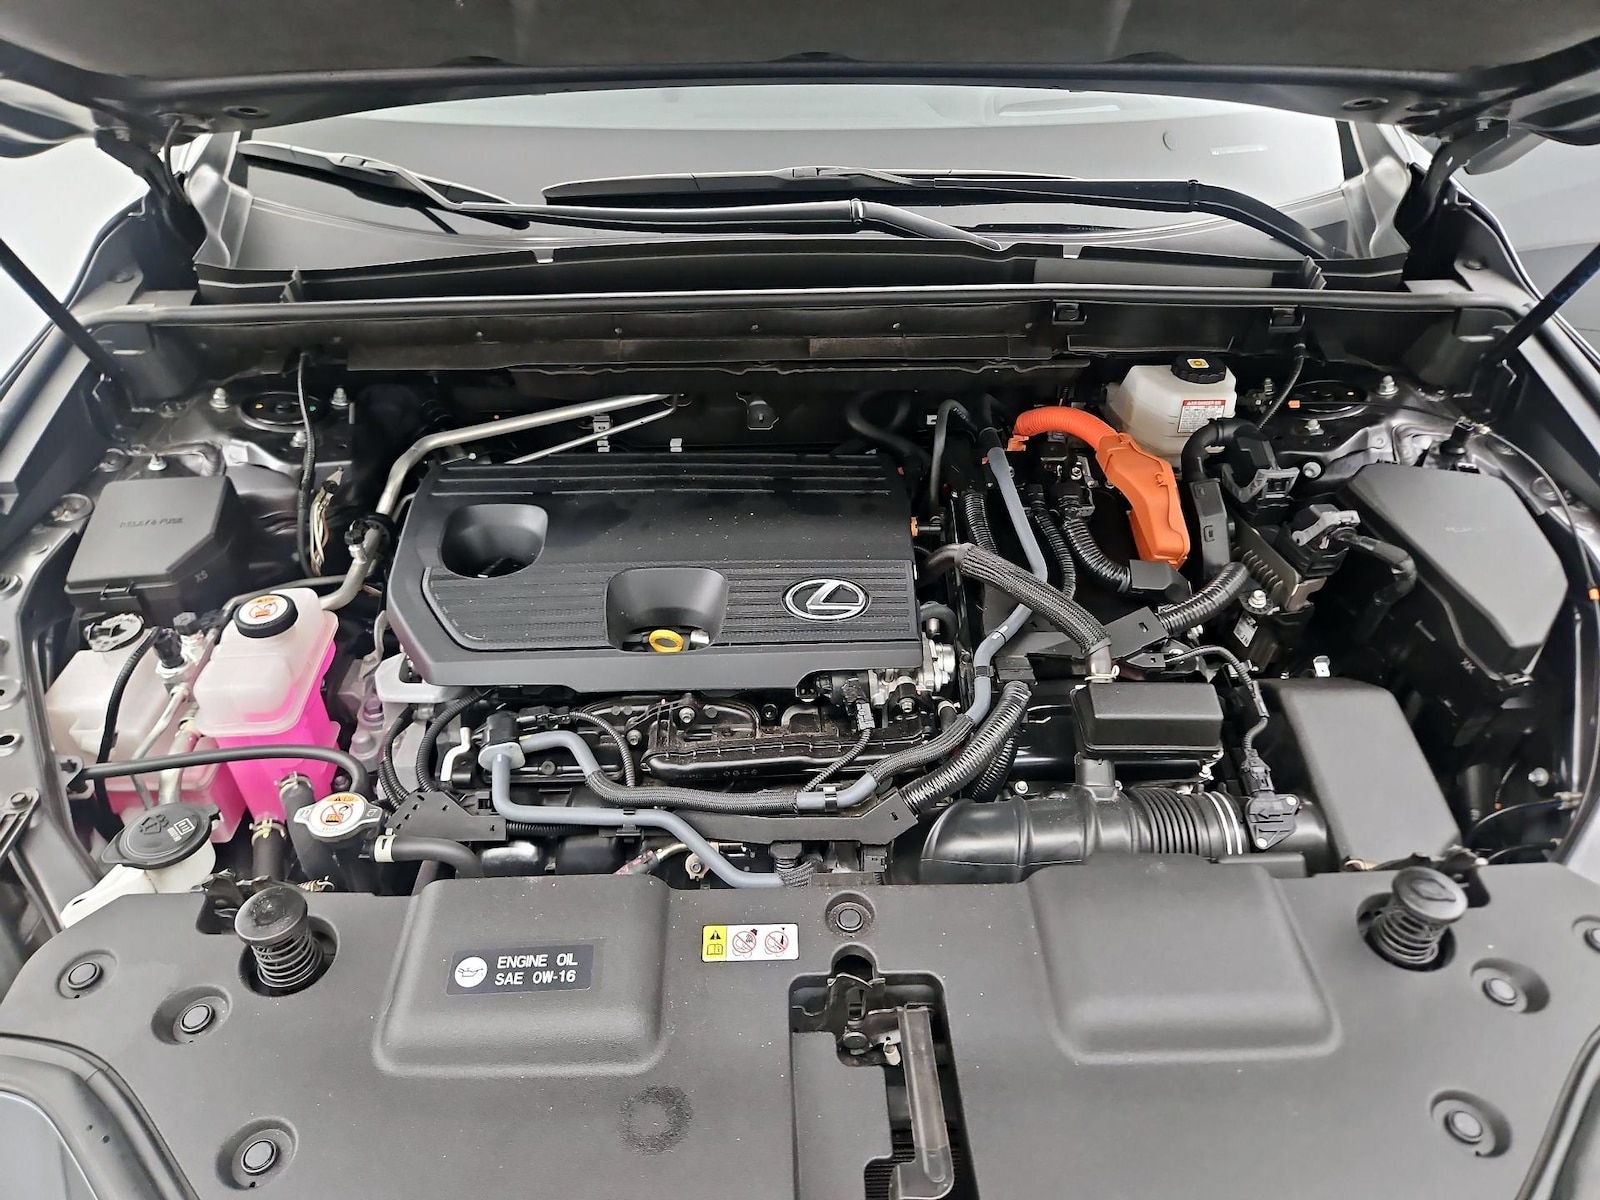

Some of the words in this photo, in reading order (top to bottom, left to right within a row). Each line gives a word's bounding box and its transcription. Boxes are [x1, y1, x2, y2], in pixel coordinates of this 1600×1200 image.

[497, 954, 548, 969] ENGINE
[556, 953, 578, 967] OIL
[495, 972, 524, 986] SAE
[532, 970, 577, 984] 0W-16
